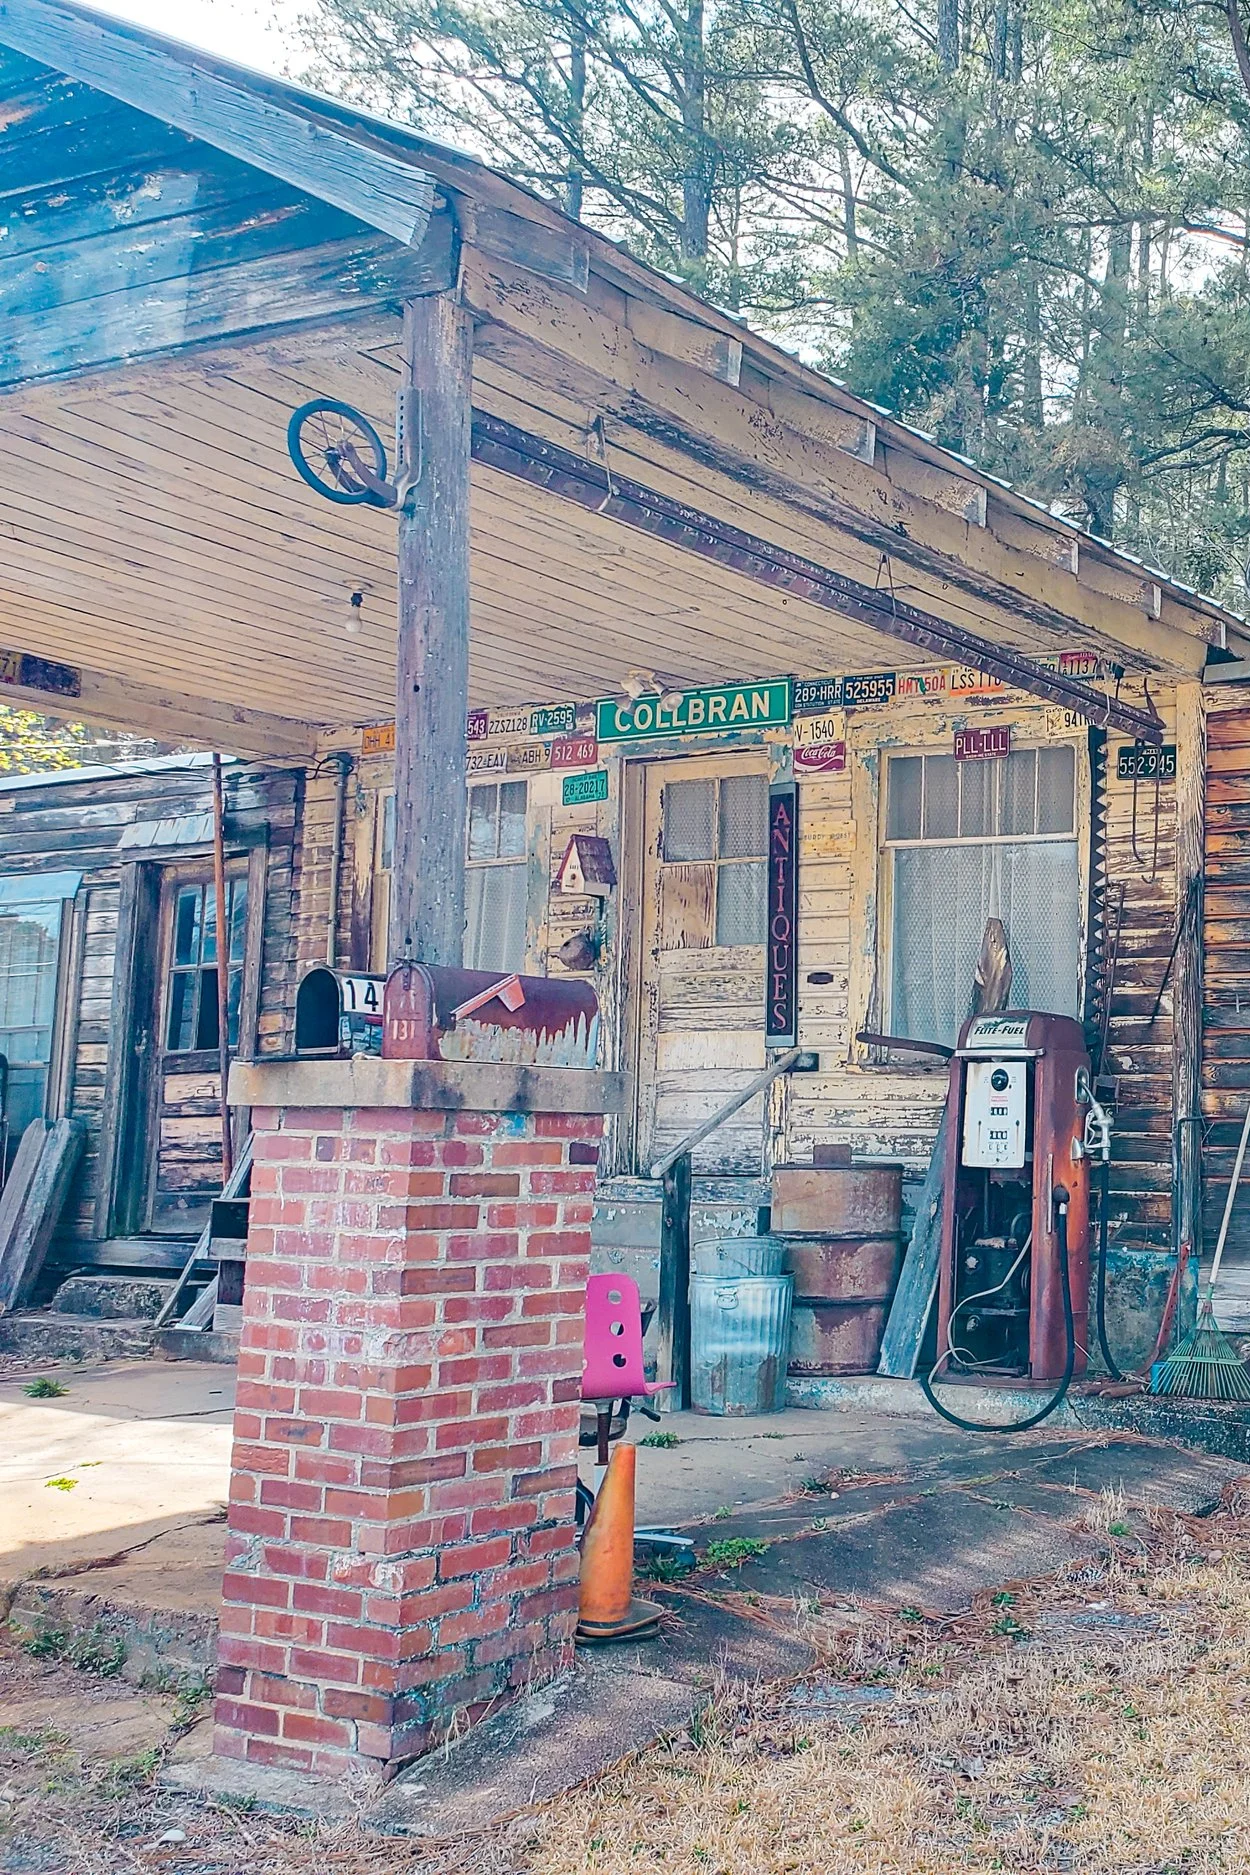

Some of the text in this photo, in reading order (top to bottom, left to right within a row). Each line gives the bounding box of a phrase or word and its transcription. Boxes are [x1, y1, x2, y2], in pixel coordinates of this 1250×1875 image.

[845, 679, 893, 700] 525955
[951, 673, 975, 690] LSS
[614, 690, 770, 732] COLLBRAN
[488, 717, 528, 735] 2ZSZ128
[521, 749, 542, 764] ABH
[554, 743, 594, 761] 512 469
[771, 801, 791, 1030] ANTIQUES
[974, 1025, 1025, 1036] FLITE-FUEL
